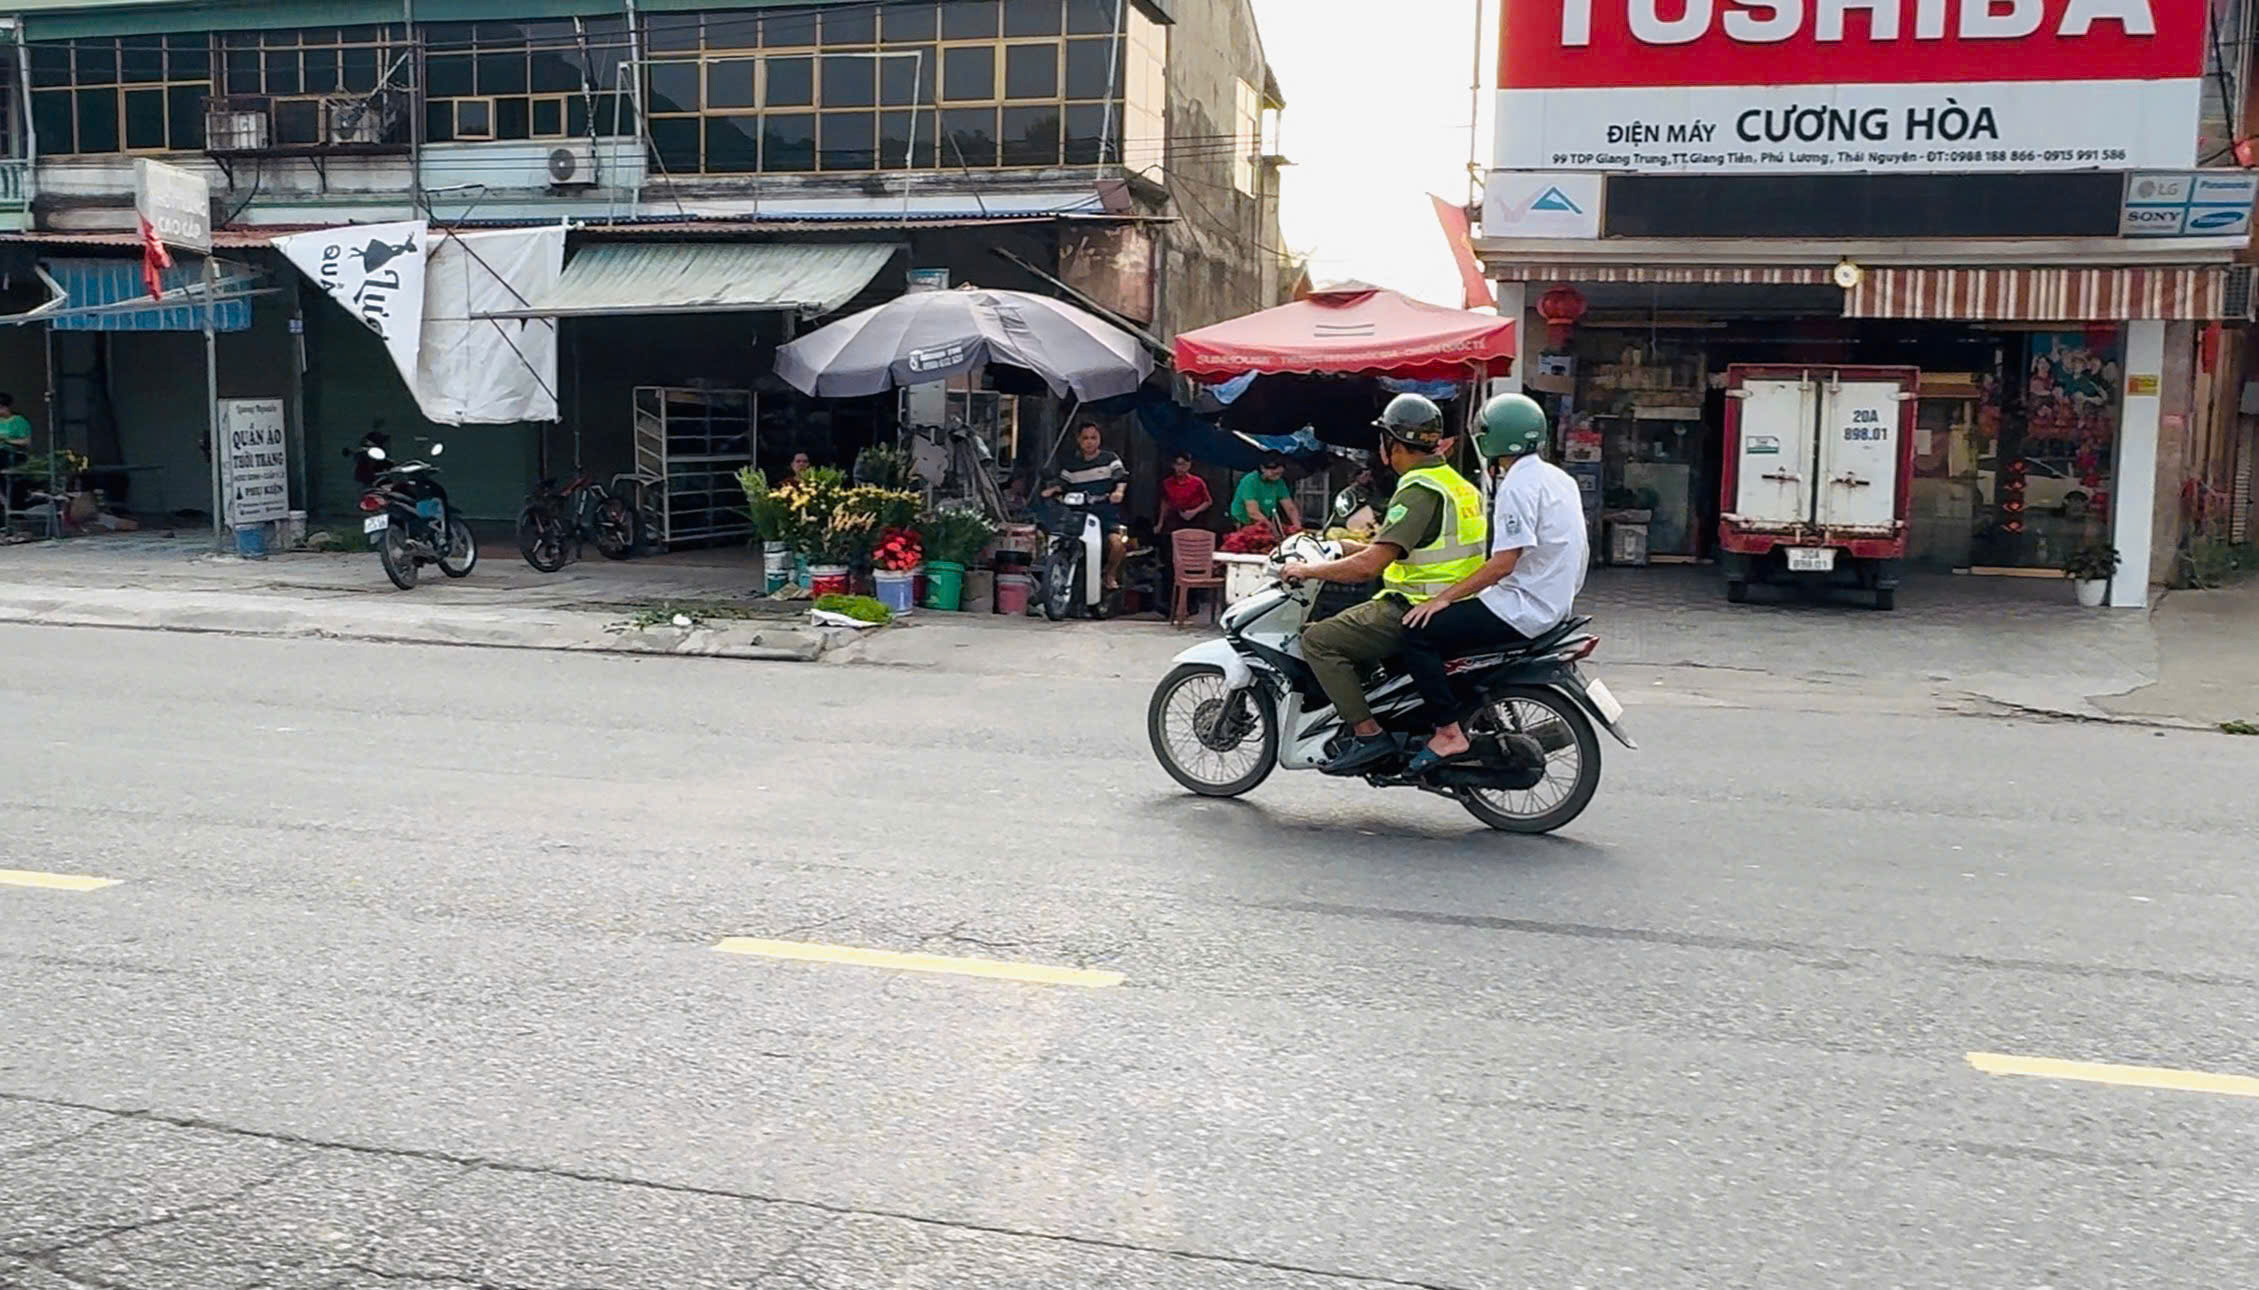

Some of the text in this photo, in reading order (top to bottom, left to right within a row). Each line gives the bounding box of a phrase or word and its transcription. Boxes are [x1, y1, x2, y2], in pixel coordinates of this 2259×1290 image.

[1606, 97, 2000, 147] ĐIỆN MÁY CƯƠNG HÒA
[1552, 153, 1568, 164] 99
[1570, 153, 1594, 164] TDP
[1595, 153, 1630, 166] Giang
[1760, 151, 1784, 163] Phú
[1837, 151, 1864, 162] Thái
[1868, 151, 1917, 165] Nguyên
[2076, 149, 2098, 160] 991
[2128, 211, 2181, 222] SONY
[1852, 409, 1879, 423] 20A
[266, 424, 282, 445] ÁO
[1843, 428, 1888, 441] 898.01
